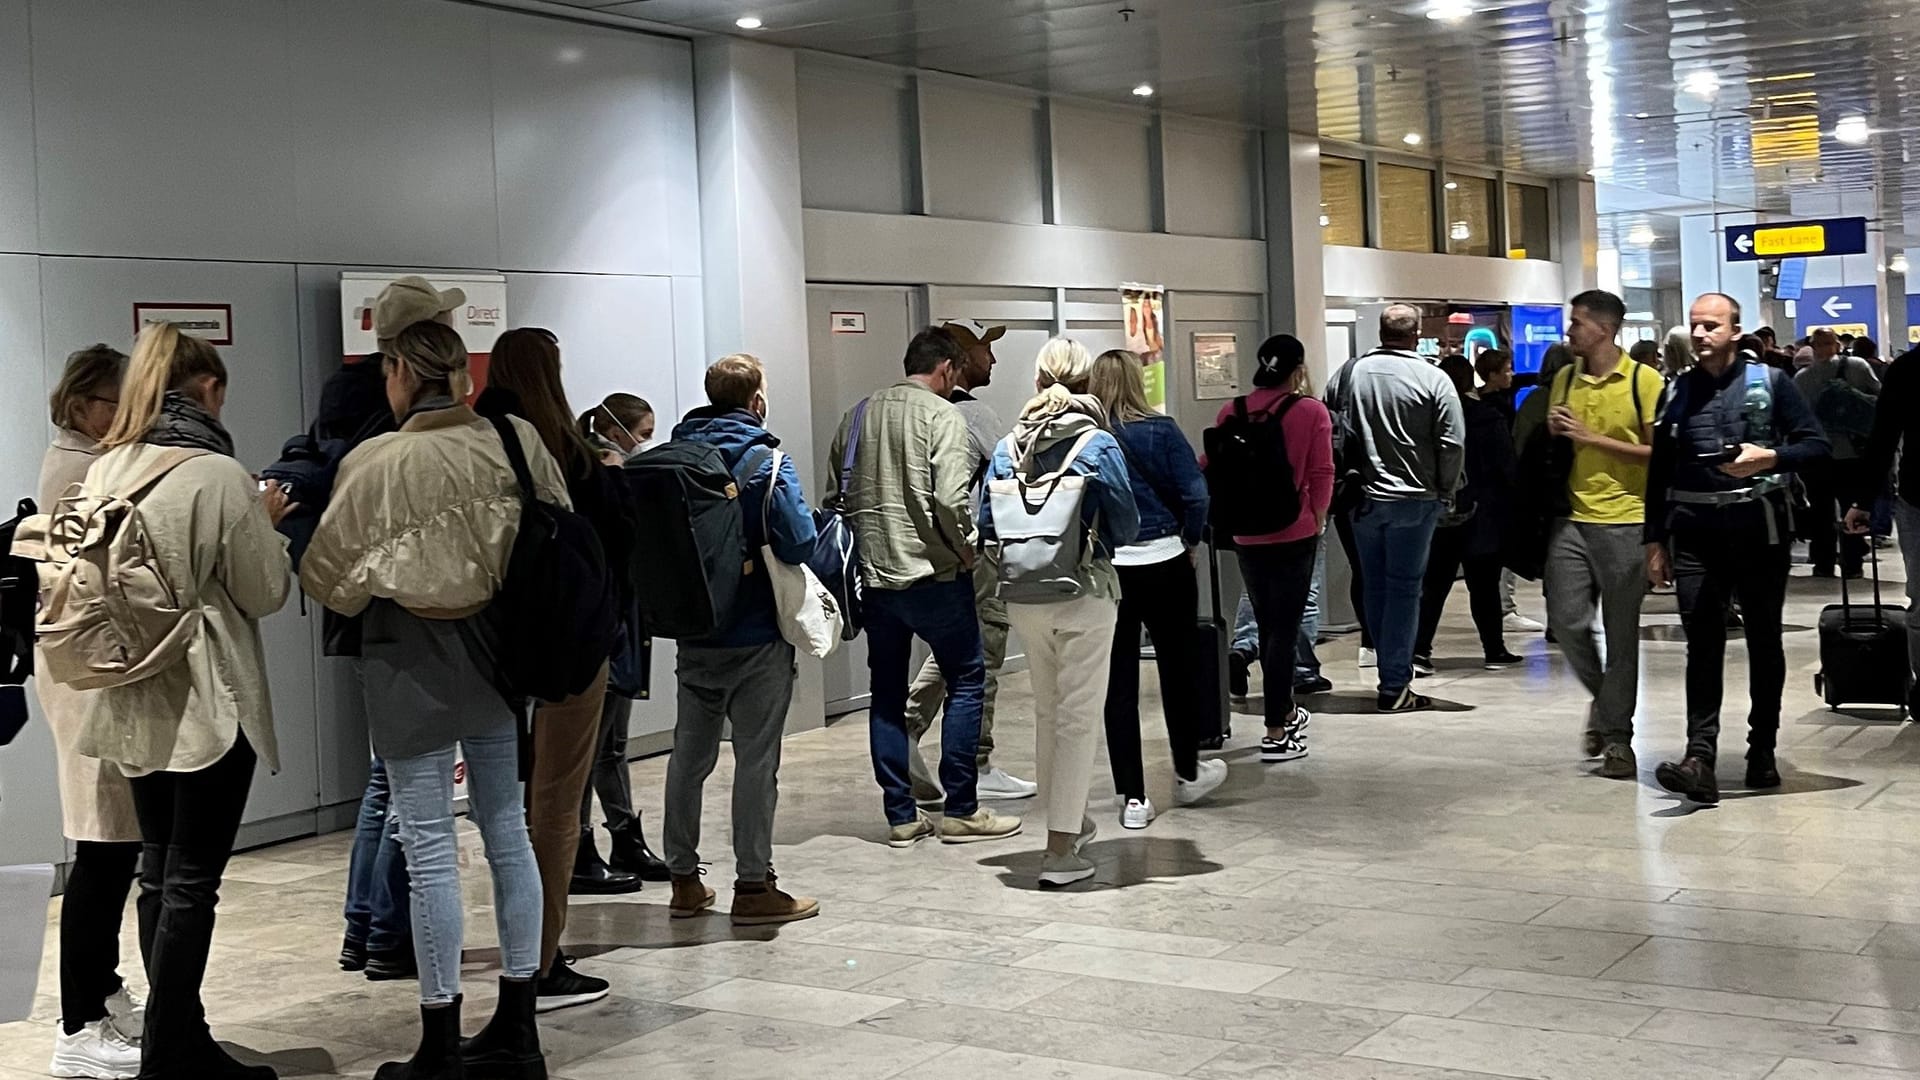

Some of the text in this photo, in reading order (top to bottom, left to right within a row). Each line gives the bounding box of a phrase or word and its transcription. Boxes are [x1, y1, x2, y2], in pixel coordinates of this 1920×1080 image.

[1761, 234, 1817, 247] Fast Lane
[467, 305, 500, 320] Direct
